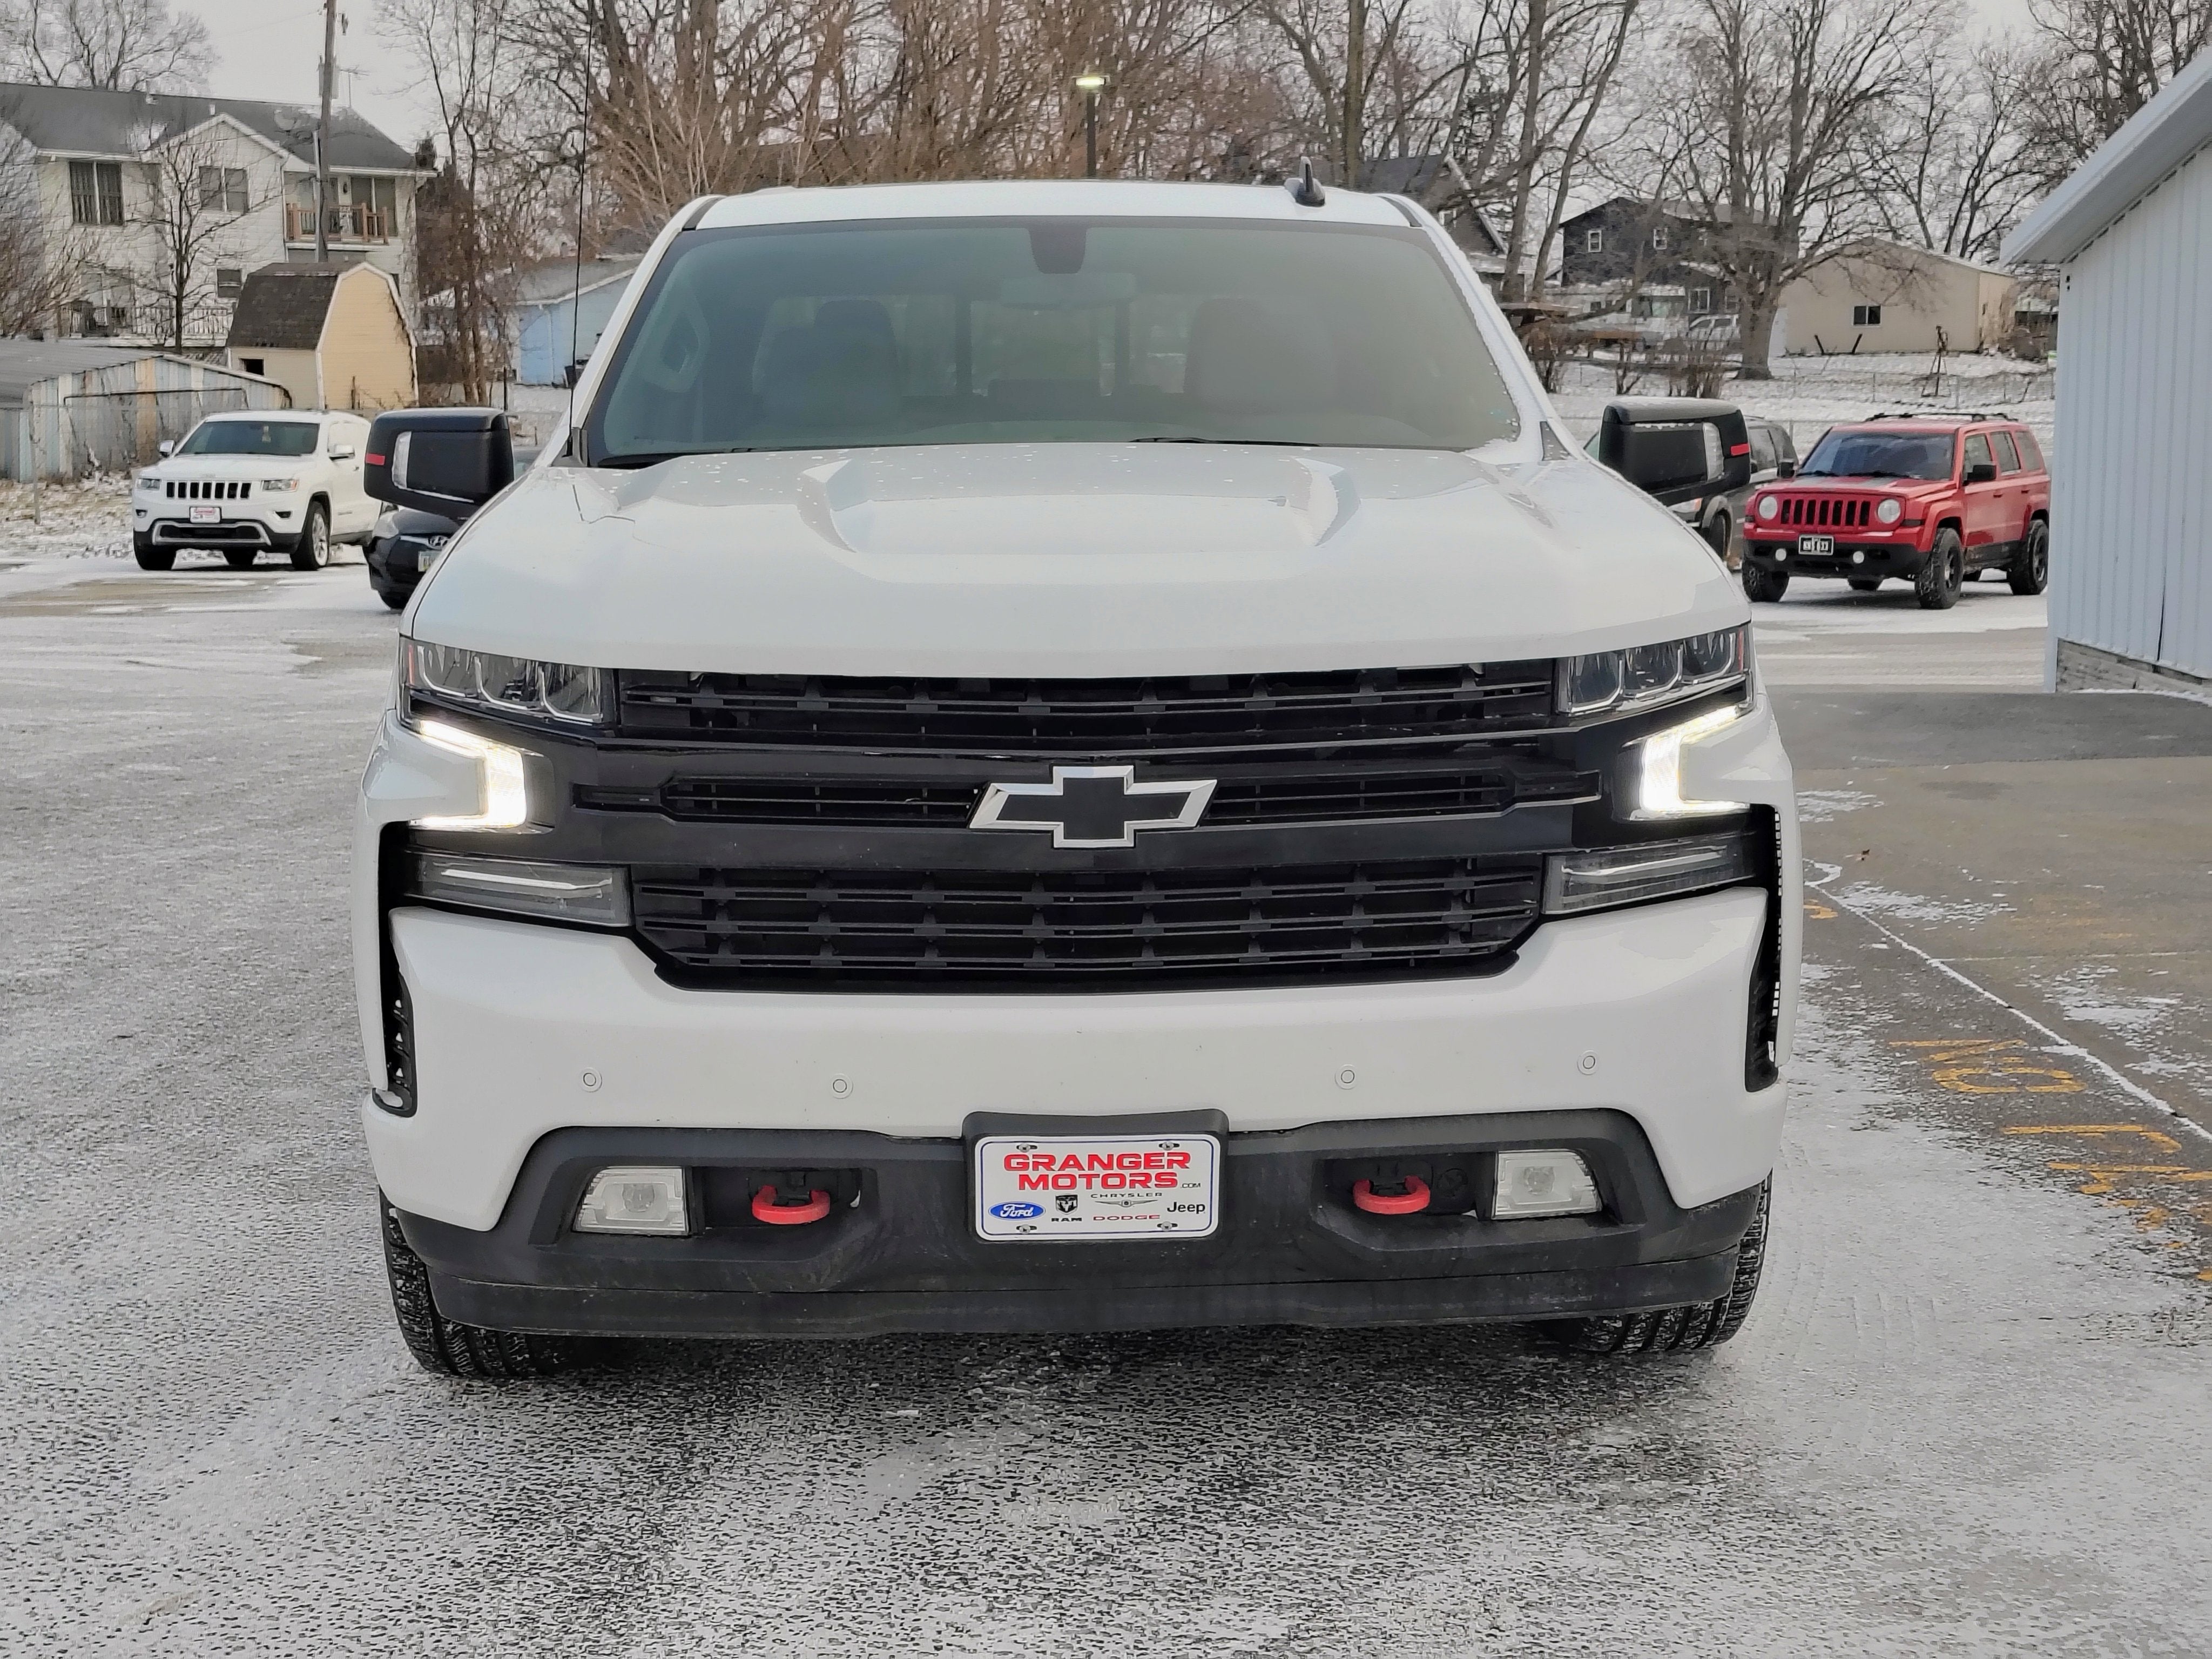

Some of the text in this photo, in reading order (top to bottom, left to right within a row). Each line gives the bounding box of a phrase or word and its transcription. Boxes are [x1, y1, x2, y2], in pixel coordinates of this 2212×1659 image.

[1004, 1152, 1191, 1171] GRANGER
[1019, 1172, 1178, 1190] MOTORS
[1000, 1203, 1033, 1218] Ford
[1167, 1202, 1205, 1215] Jeep
